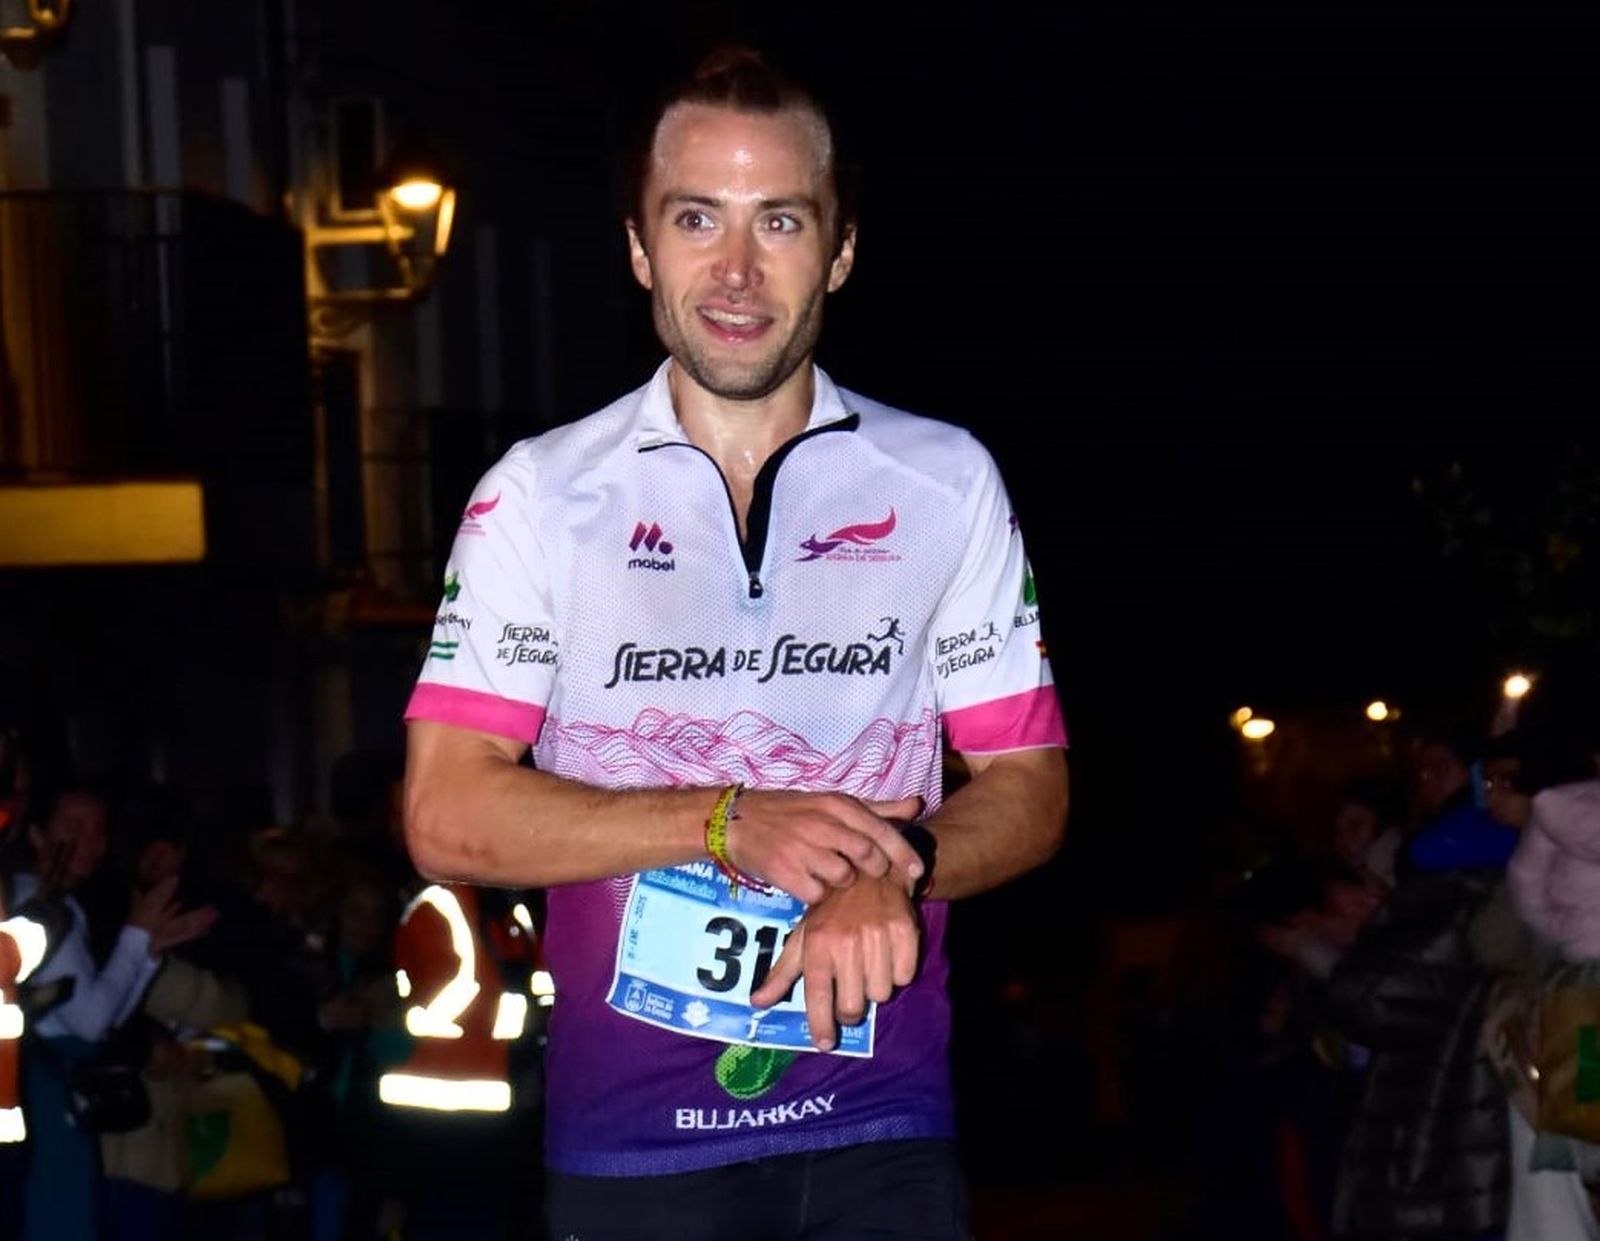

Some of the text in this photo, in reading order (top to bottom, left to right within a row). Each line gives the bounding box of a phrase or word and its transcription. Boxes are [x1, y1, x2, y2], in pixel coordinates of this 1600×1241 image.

[497, 623, 550, 644] SIERRA
[604, 634, 891, 689] SIERRA DE SEGURA
[675, 1093, 836, 1130] BUJARKAY
